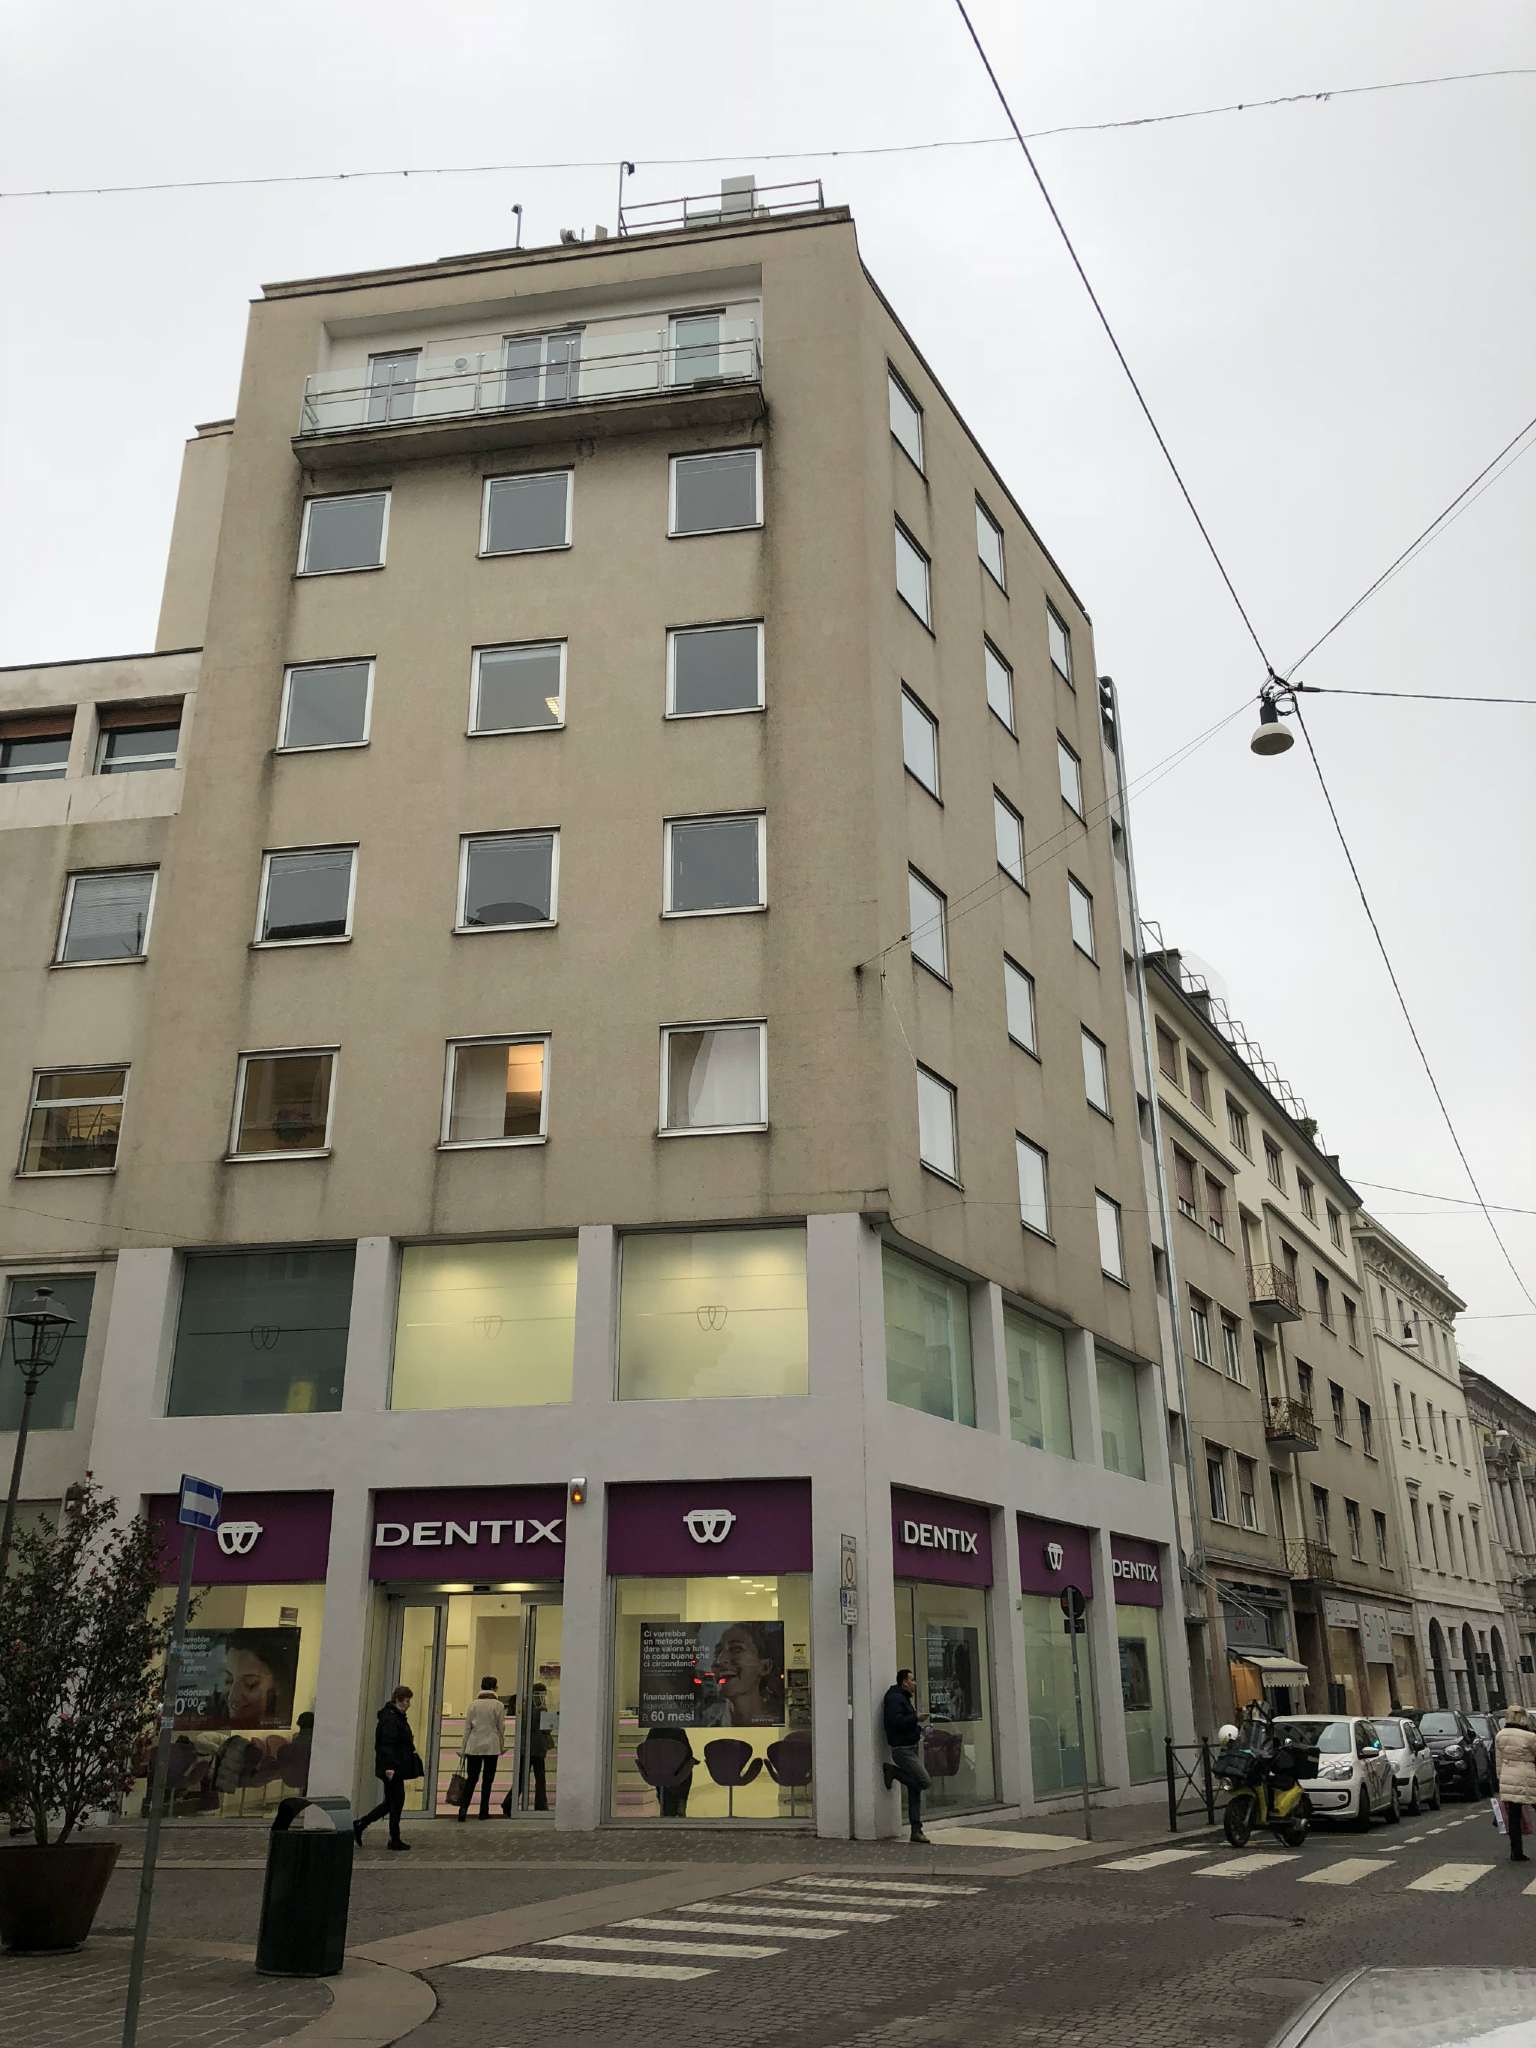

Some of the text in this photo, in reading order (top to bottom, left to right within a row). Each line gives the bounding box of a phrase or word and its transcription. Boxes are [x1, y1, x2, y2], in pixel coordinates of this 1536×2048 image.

[375, 1519, 564, 1547] DENTIX
[904, 1520, 978, 1554] DENTIX
[1112, 1557, 1158, 1584] DENTIX
[653, 1630, 686, 1638] vorrebbe
[643, 1692, 695, 1701] finanziamenti
[651, 1710, 665, 1722] 60
[667, 1711, 695, 1722] mesi
